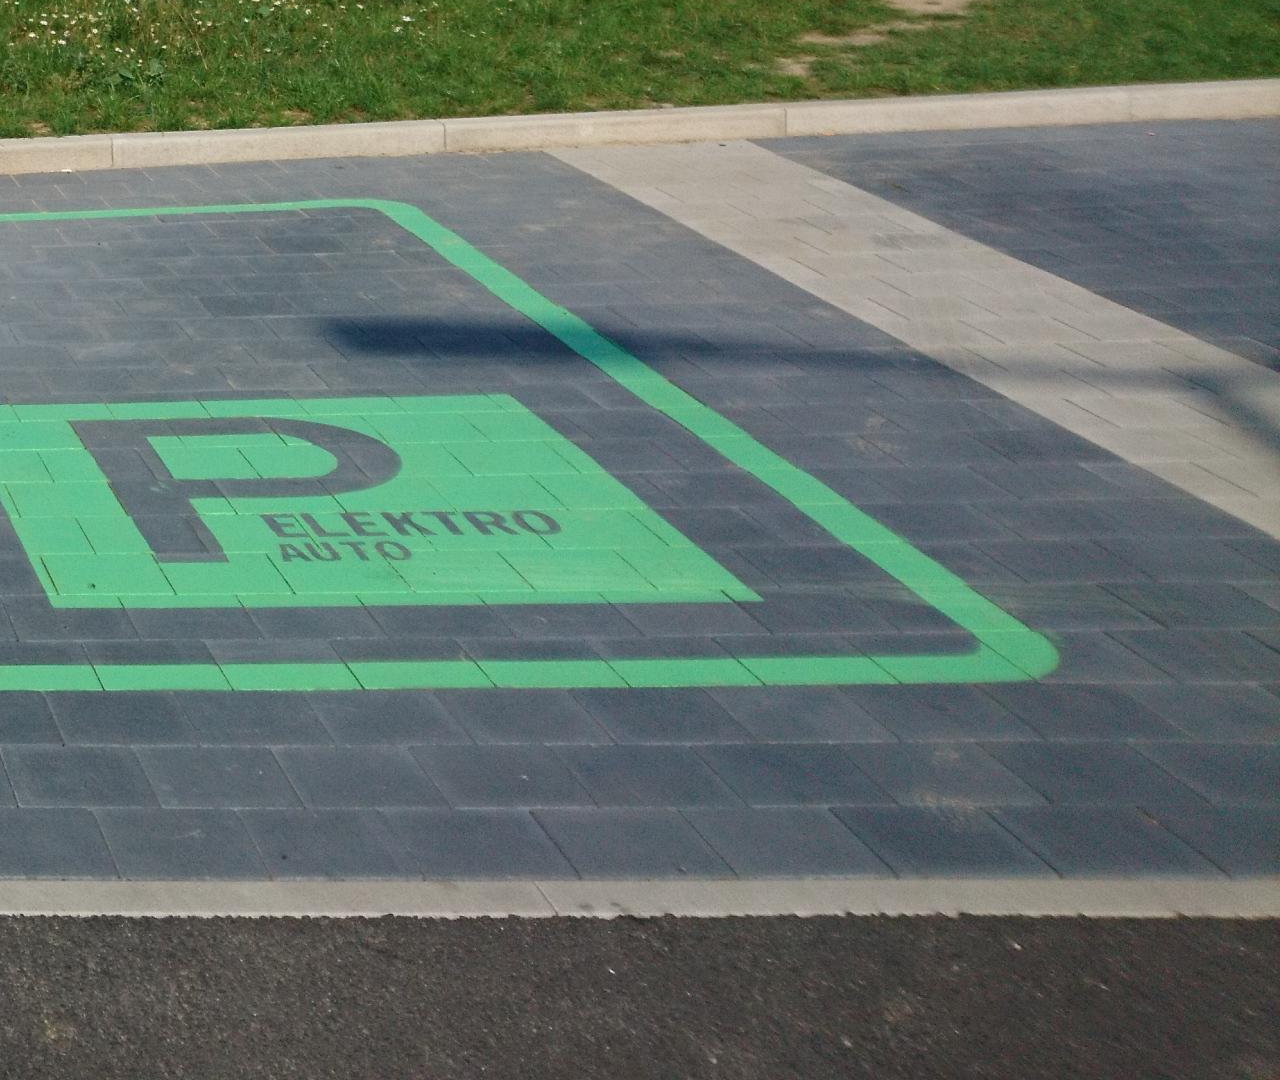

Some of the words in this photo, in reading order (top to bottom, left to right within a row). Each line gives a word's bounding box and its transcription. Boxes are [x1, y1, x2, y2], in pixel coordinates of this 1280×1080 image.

[69, 416, 401, 564] P
[258, 510, 562, 538] ELEKTRO
[277, 540, 413, 563] AUTO
